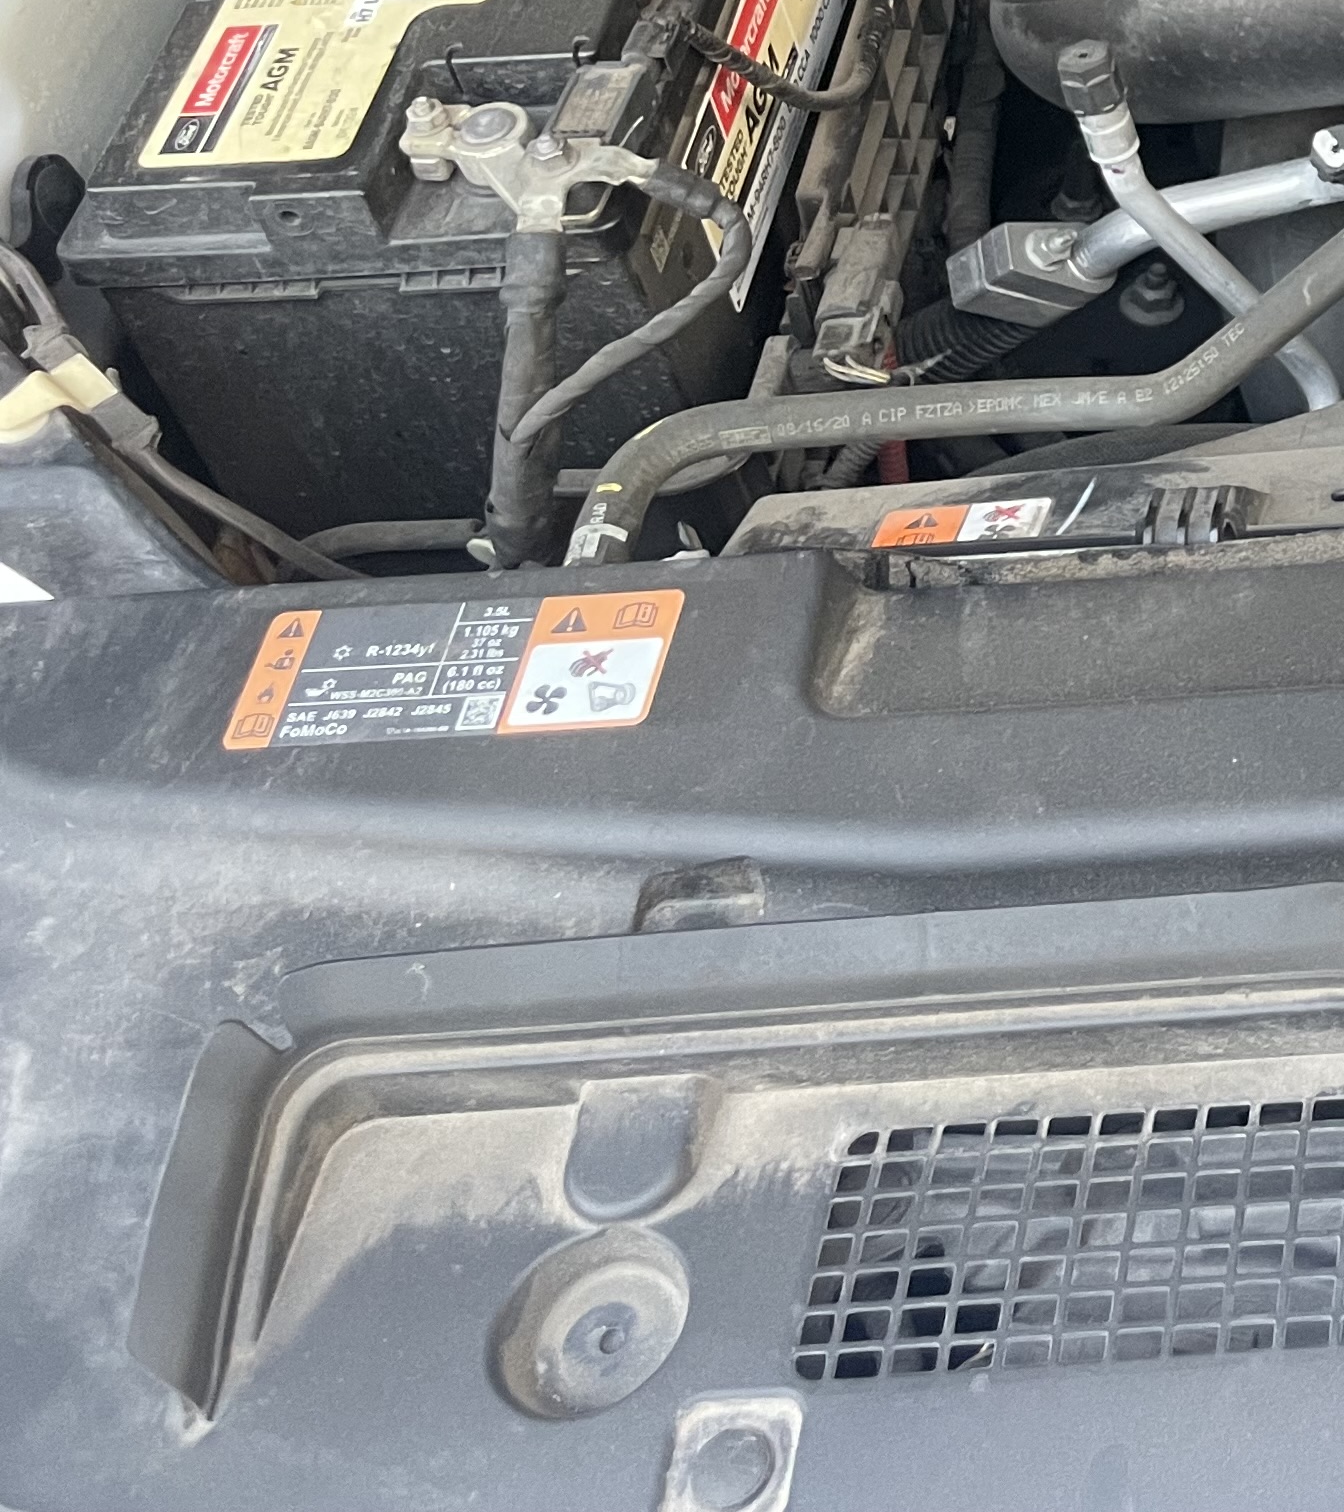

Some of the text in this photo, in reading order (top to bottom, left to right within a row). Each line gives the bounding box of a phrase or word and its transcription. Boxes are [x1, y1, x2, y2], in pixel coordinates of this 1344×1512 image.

[797, 45, 810, 83] CCA
[809, 4, 824, 47] 1000
[193, 31, 250, 106] Motorcraft
[257, 46, 300, 91] AGM
[174, 124, 200, 145] Ford
[719, 125, 744, 193] TESTED
[1221, 323, 1246, 347] TEC
[462, 624, 520, 638] 1.105 kg
[364, 642, 436, 659] R-1234yf
[391, 670, 429, 684] PAG
[445, 666, 472, 677] 6.1
[486, 666, 505, 674] oz
[440, 677, 502, 693] (180 cc)
[285, 703, 453, 722] SAE J639 J2842 J2845
[277, 722, 349, 739] FoMoCo
